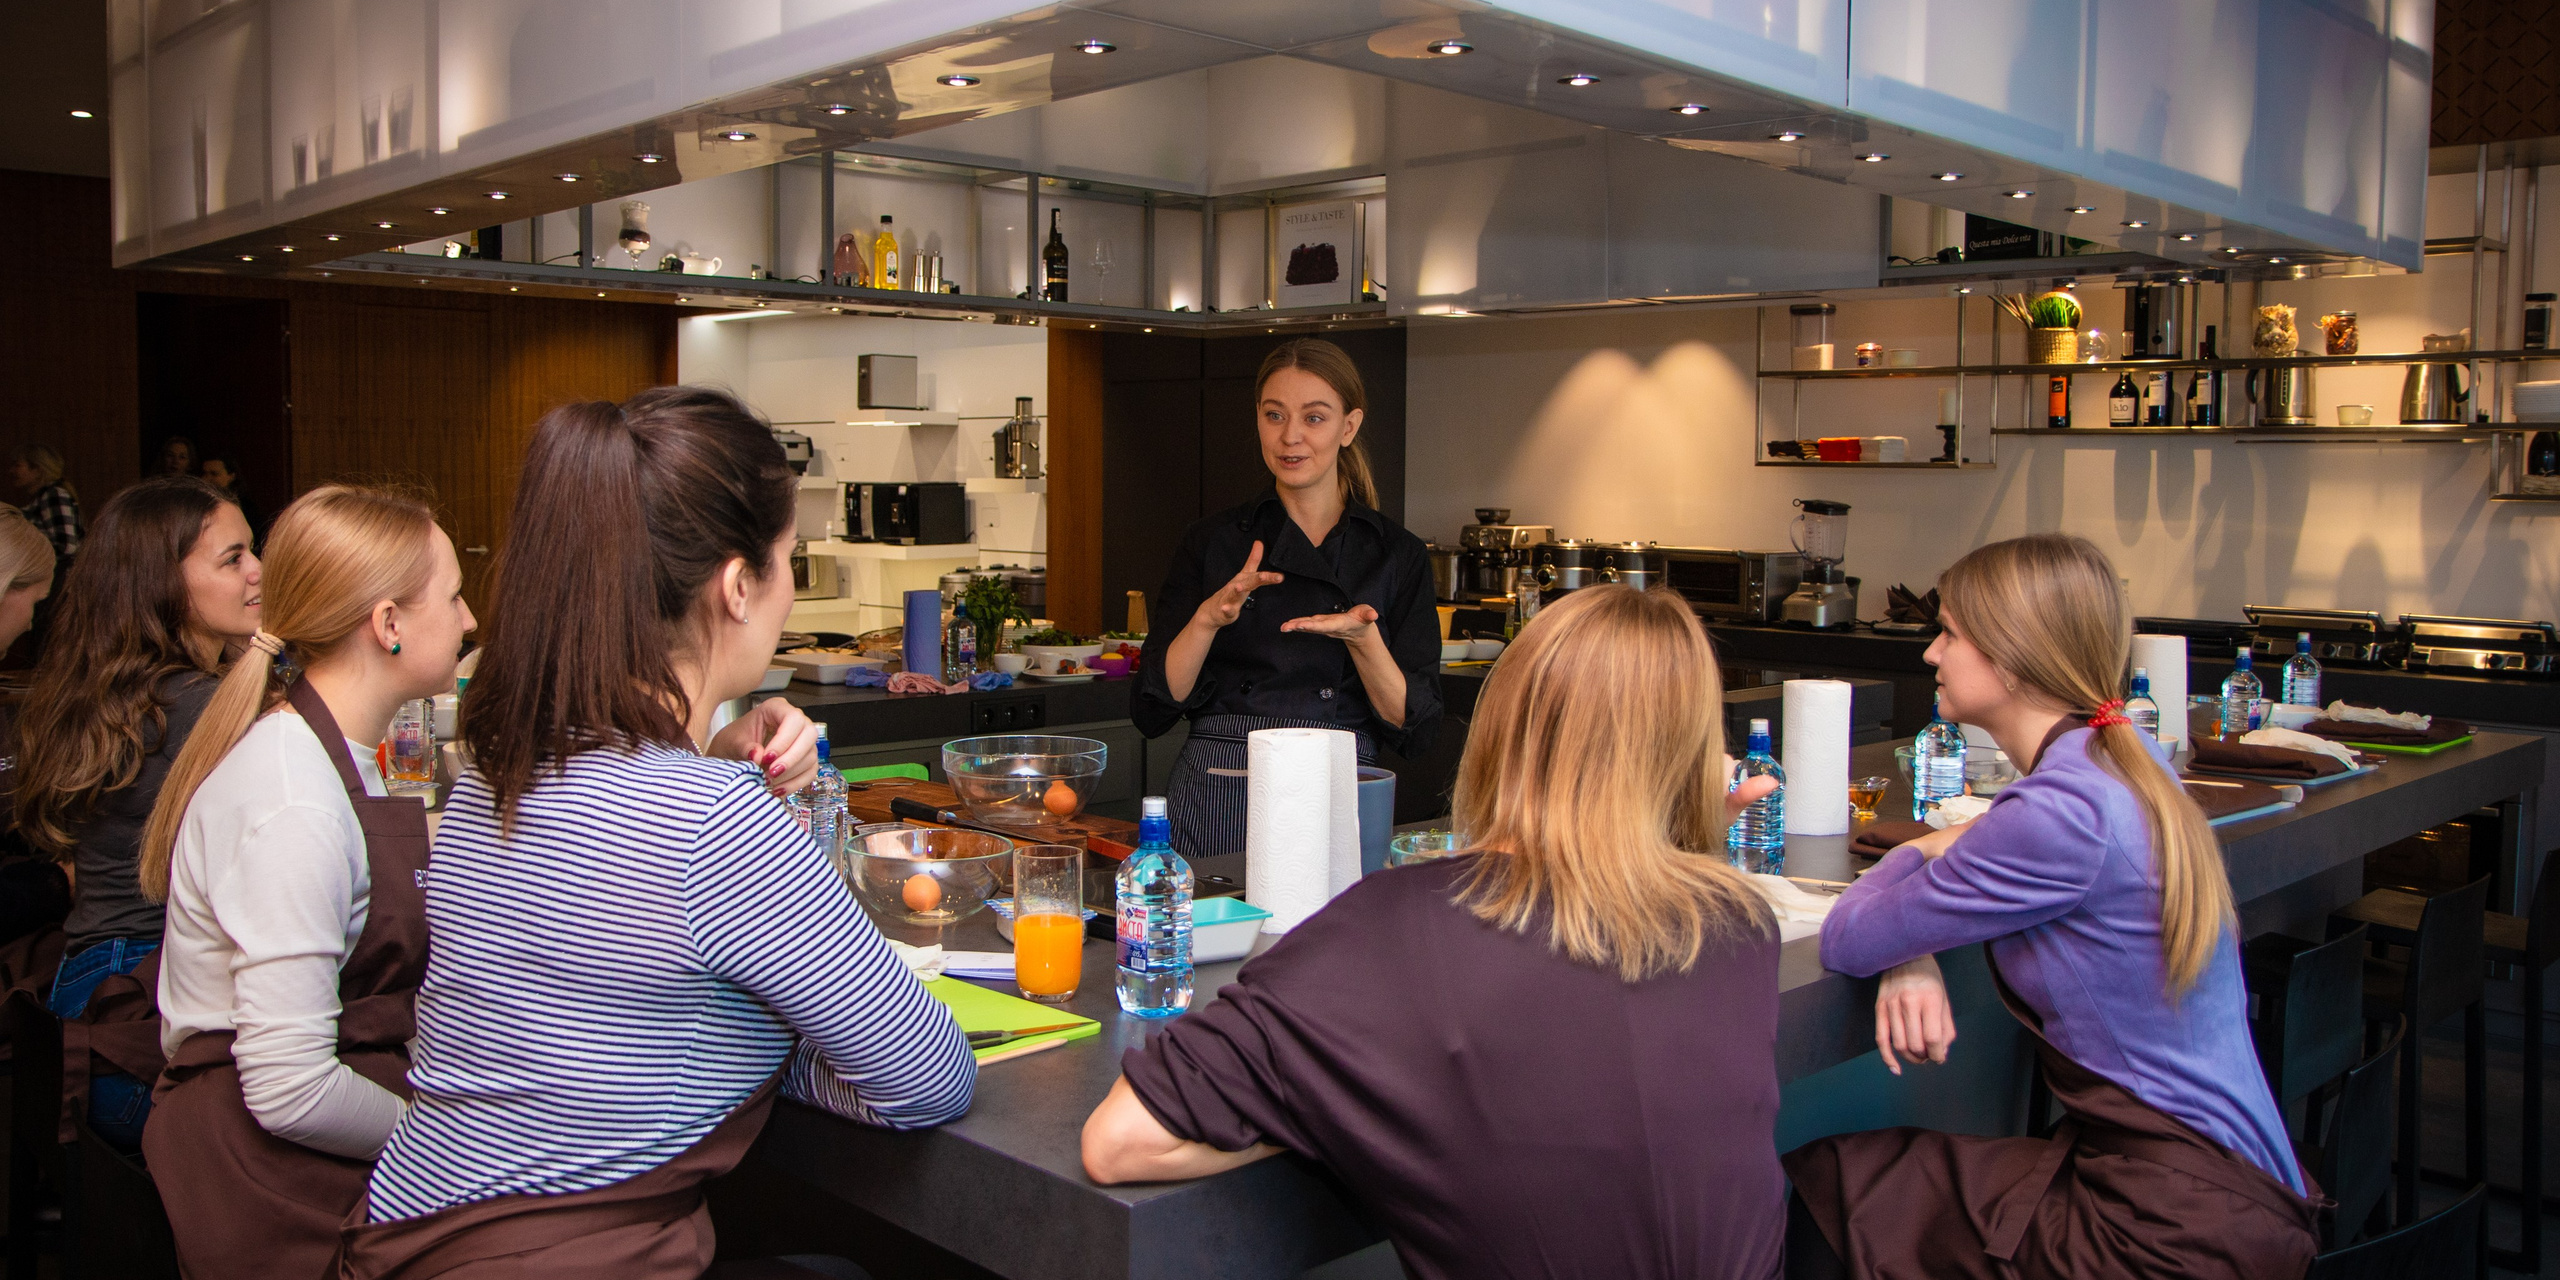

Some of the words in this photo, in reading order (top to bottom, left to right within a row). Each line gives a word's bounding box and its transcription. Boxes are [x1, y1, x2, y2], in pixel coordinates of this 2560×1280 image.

[1285, 213, 1310, 225] STYLE
[1311, 214, 1318, 222] &
[1318, 209, 1345, 221] TASTE
[1969, 240, 1990, 251] Questa
[2002, 234, 2018, 245] Dolce
